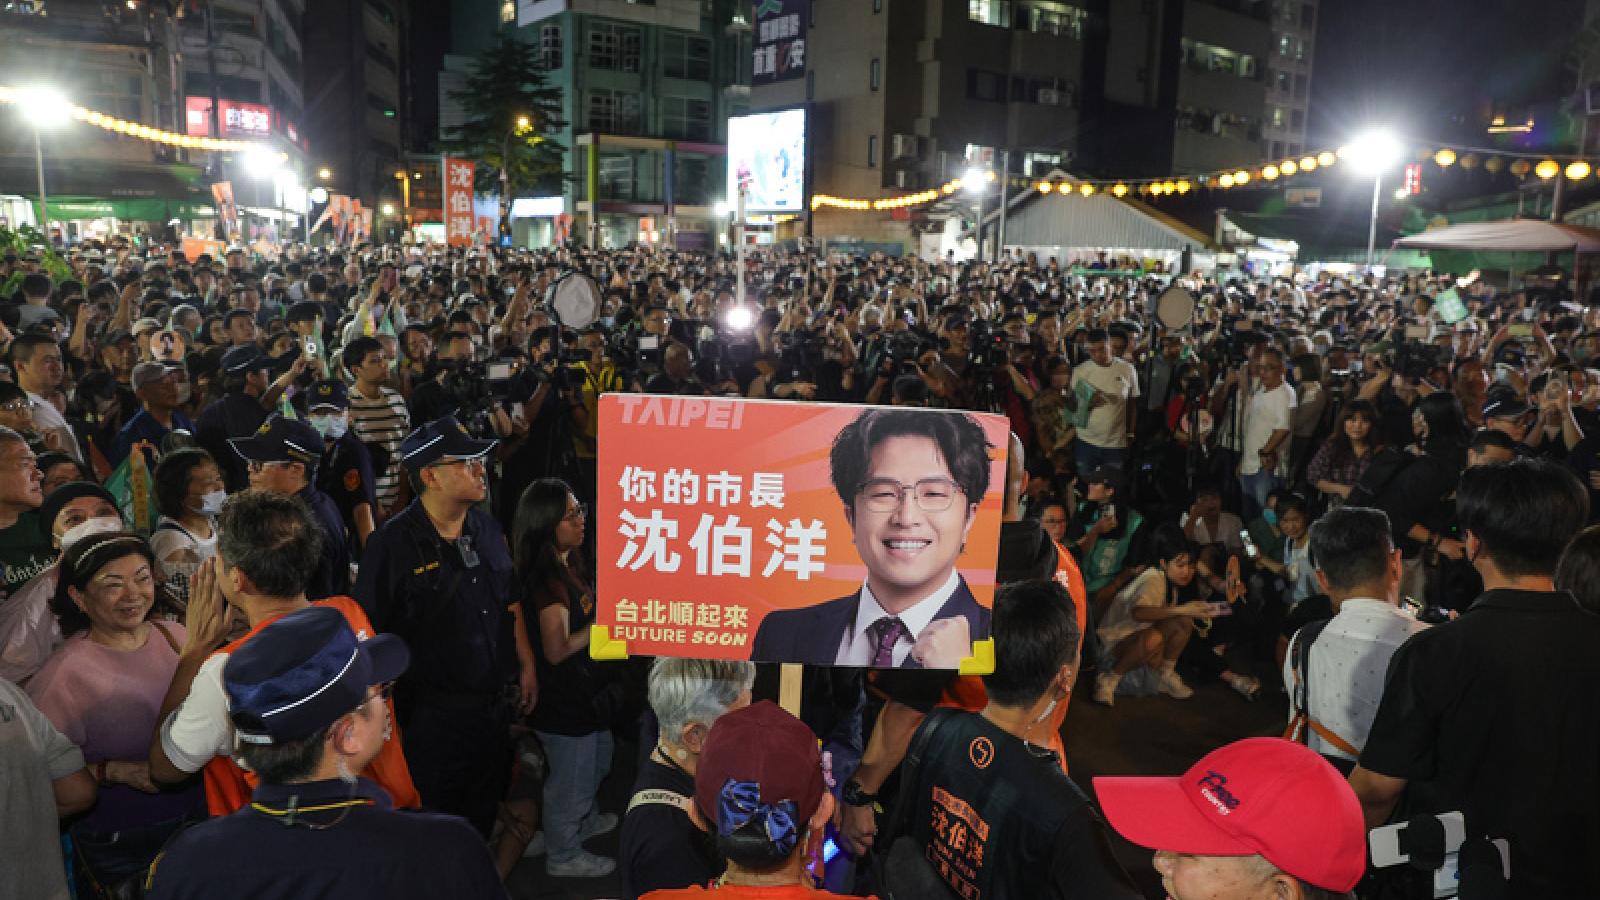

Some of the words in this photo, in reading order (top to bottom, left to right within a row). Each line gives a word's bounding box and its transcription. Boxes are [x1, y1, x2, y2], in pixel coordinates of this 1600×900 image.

[450, 164, 471, 238] 沈伯洋
[616, 396, 745, 429] TAIPEI
[617, 465, 785, 509] 你的市長
[615, 508, 827, 581] 沈伯洋
[615, 598, 748, 629] 台北順起來
[613, 625, 686, 643] FUTURE
[691, 631, 748, 646] SOON
